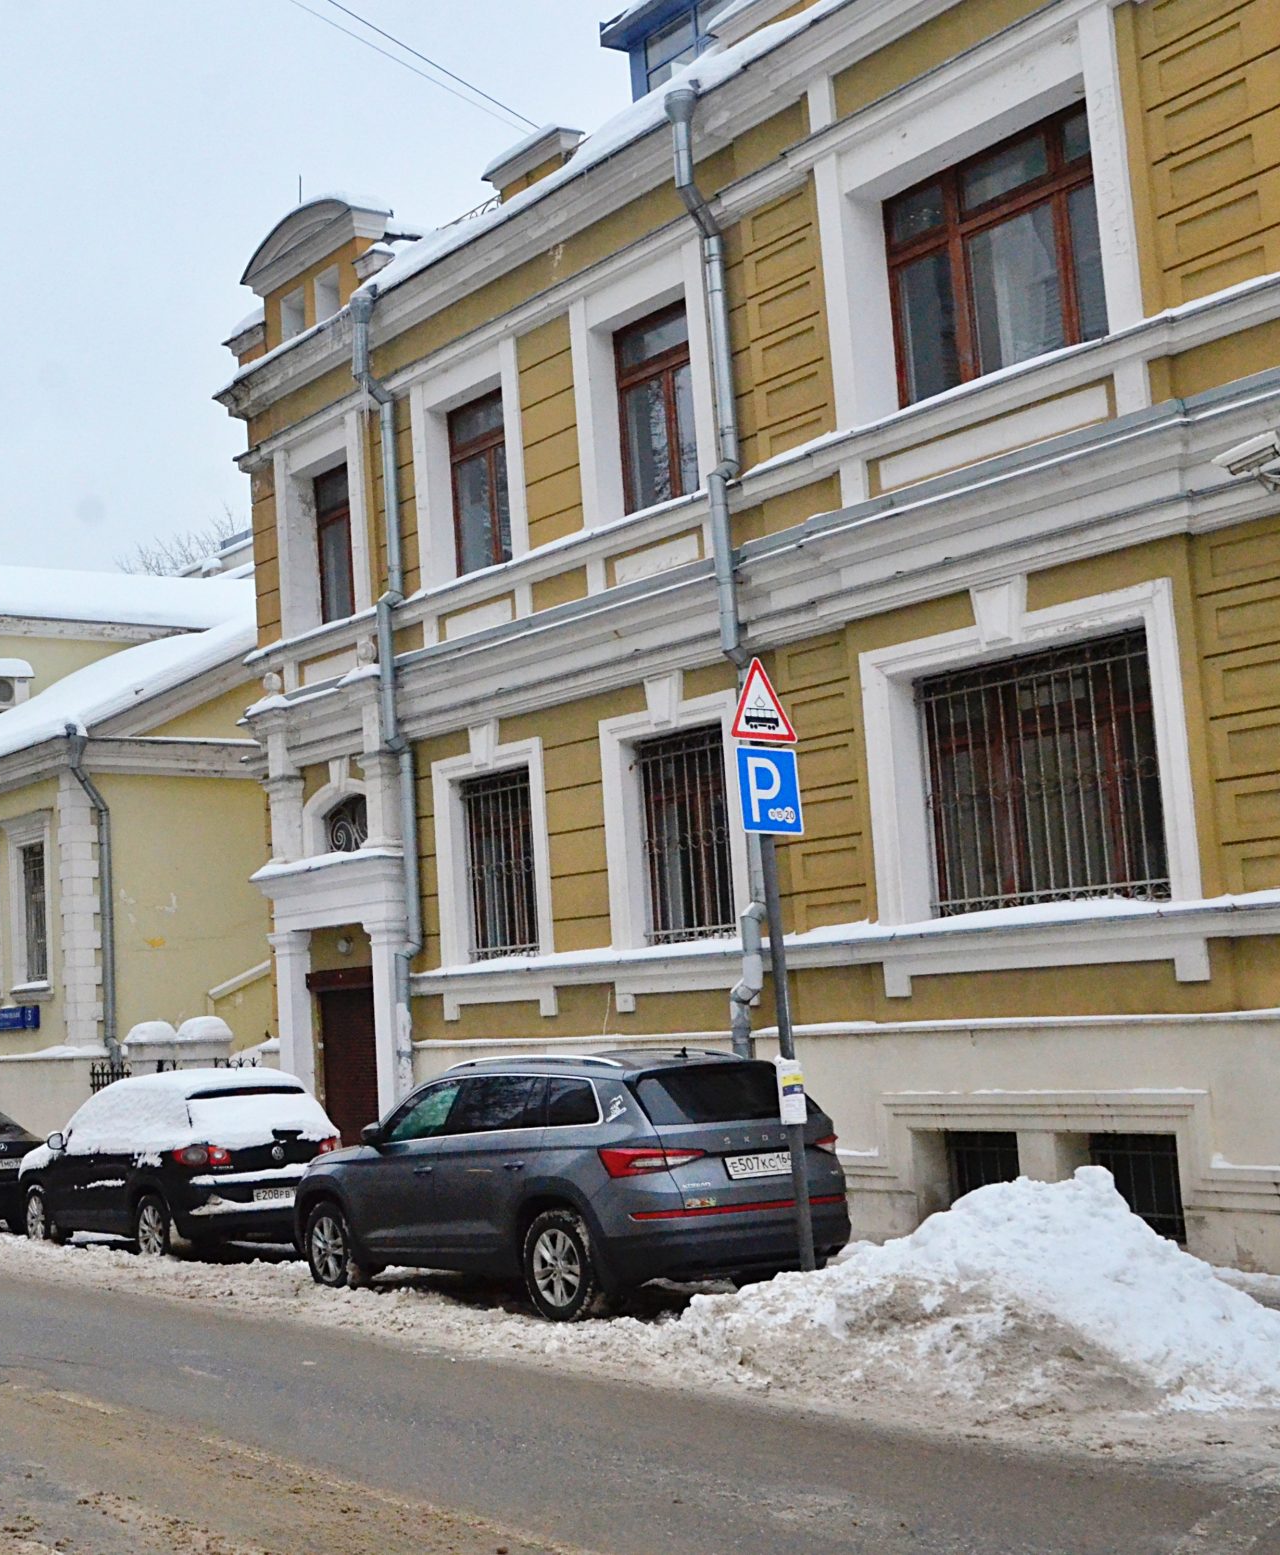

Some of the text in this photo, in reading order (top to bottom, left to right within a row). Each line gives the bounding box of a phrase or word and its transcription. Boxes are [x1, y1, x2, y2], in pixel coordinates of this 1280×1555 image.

[747, 757, 781, 822] P
[785, 810, 795, 820] 20
[723, 1133, 786, 1144] SKOD
